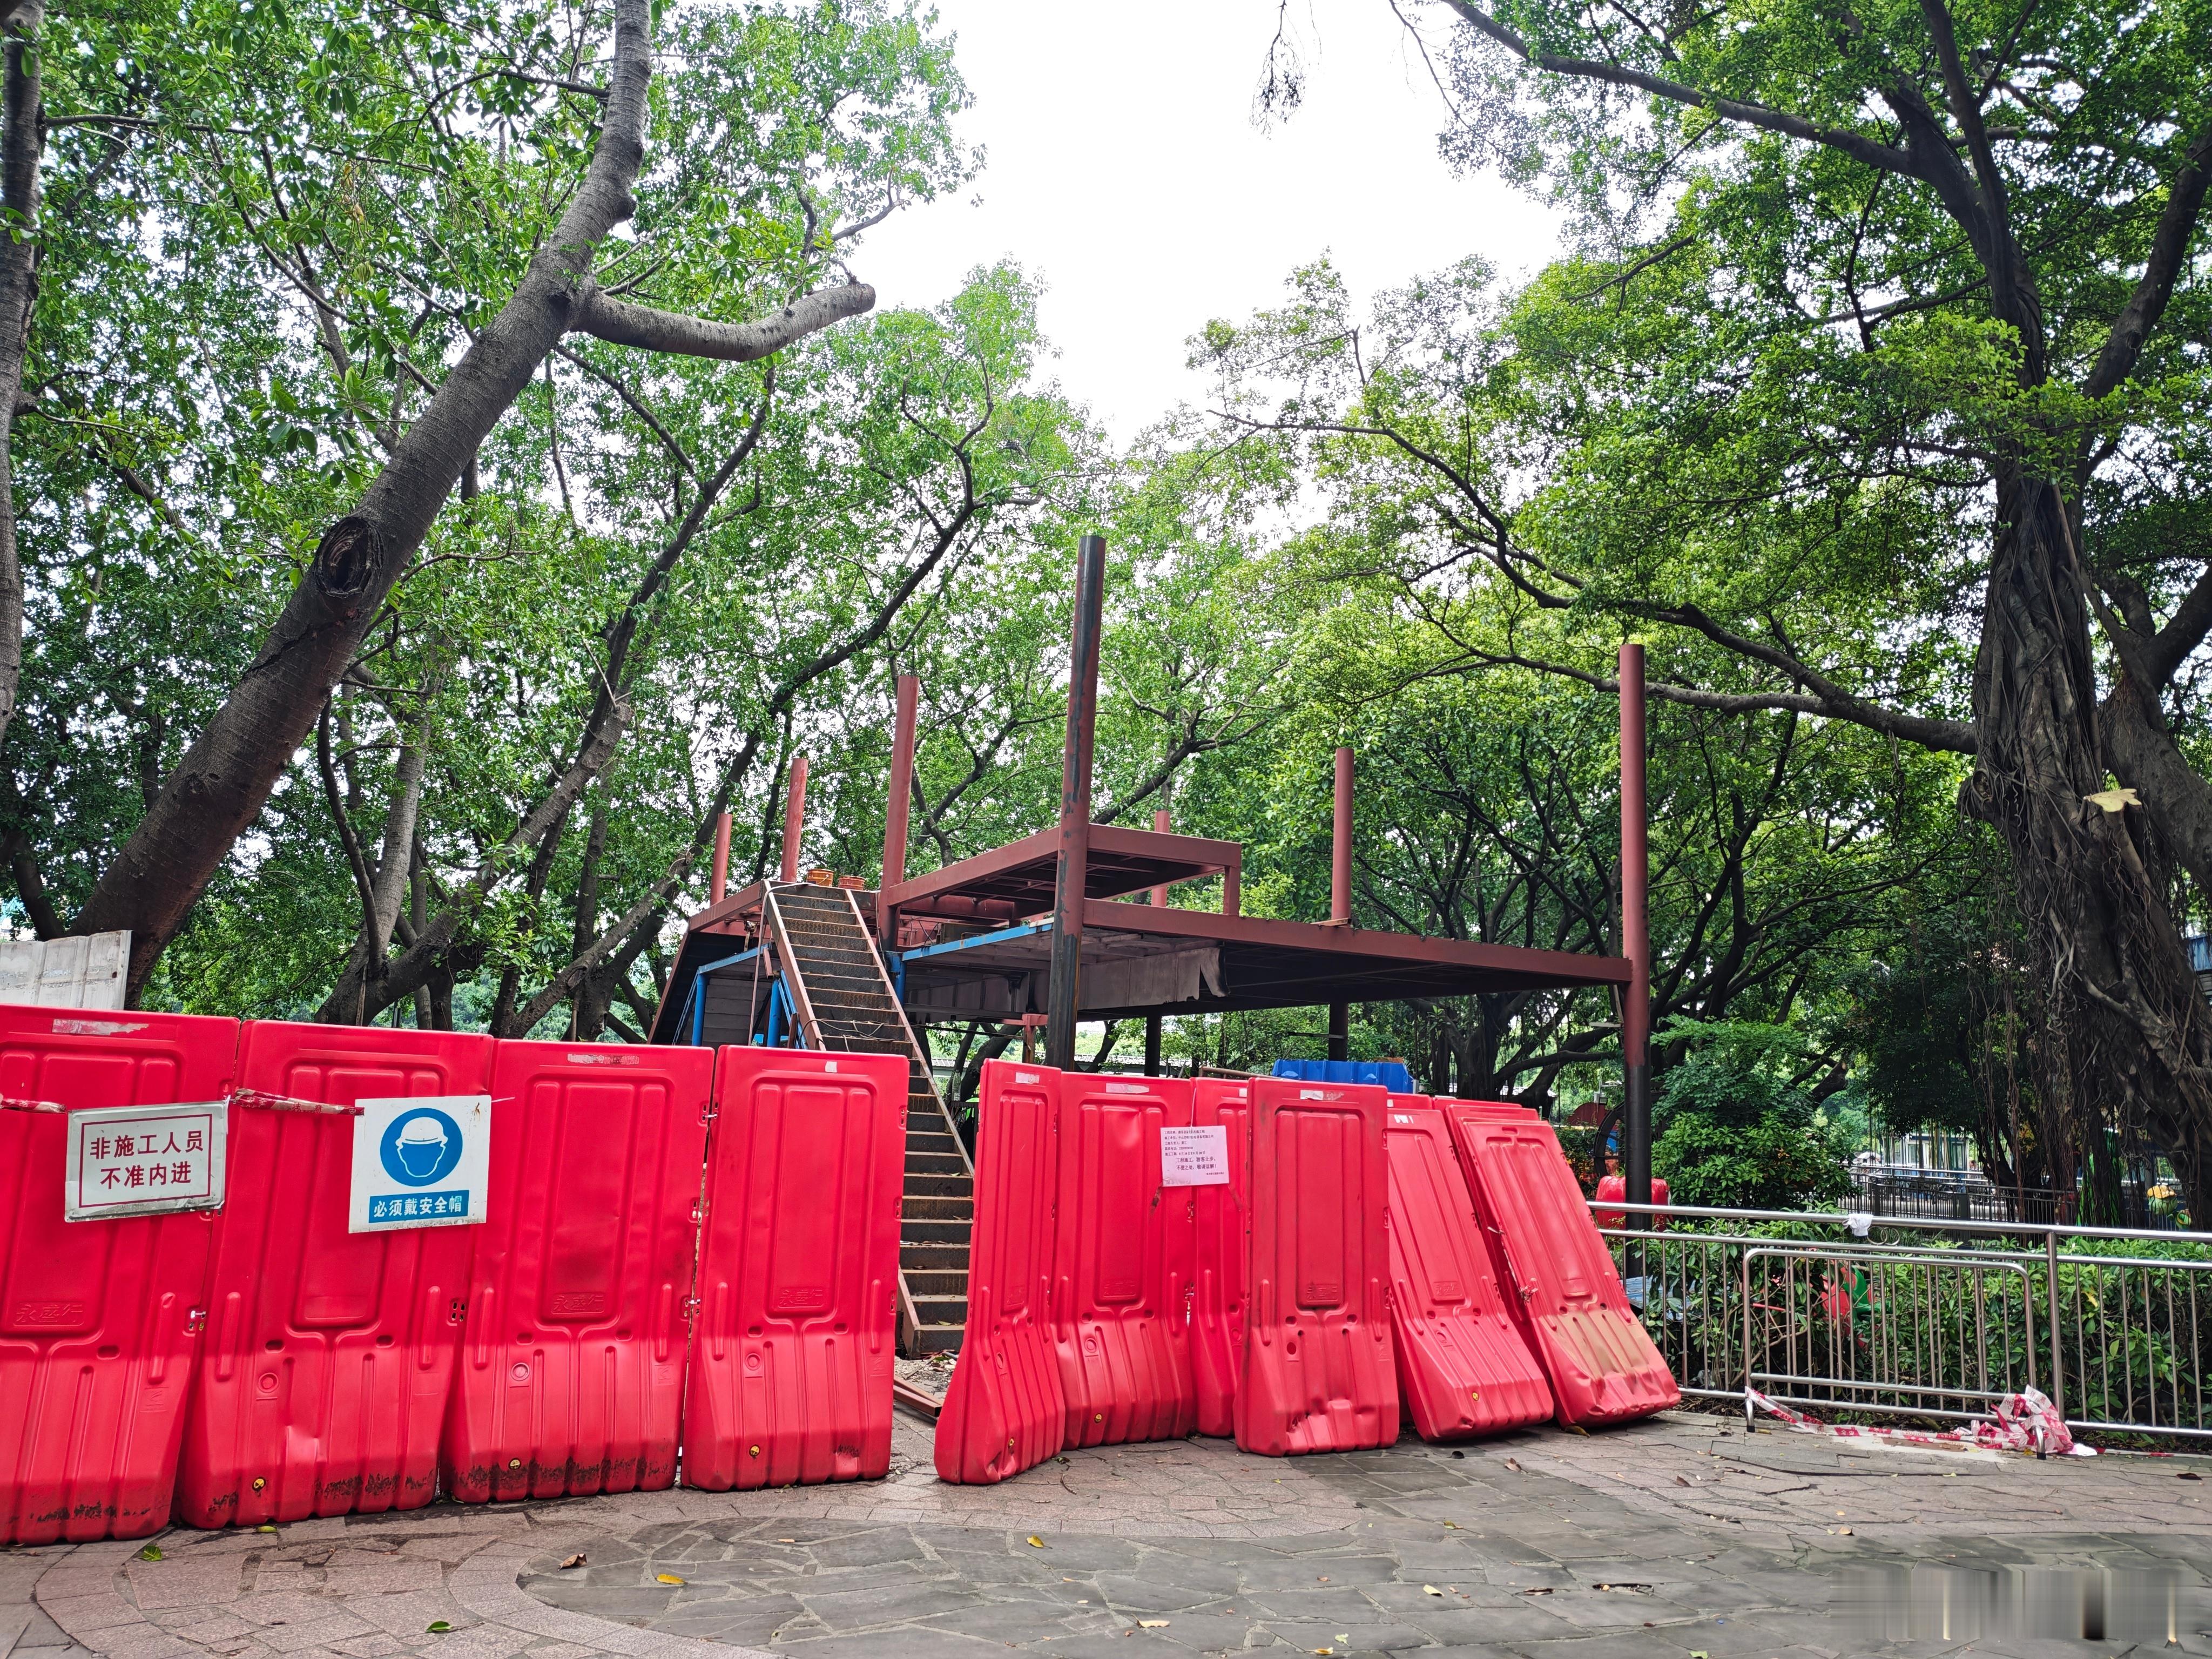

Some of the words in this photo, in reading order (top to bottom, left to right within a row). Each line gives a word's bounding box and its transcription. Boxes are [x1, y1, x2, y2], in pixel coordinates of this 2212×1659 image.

[89, 1130, 204, 1159] 非施工人员
[100, 1161, 192, 1190] 不准内进
[373, 1195, 463, 1218] 必须戴安全帽
